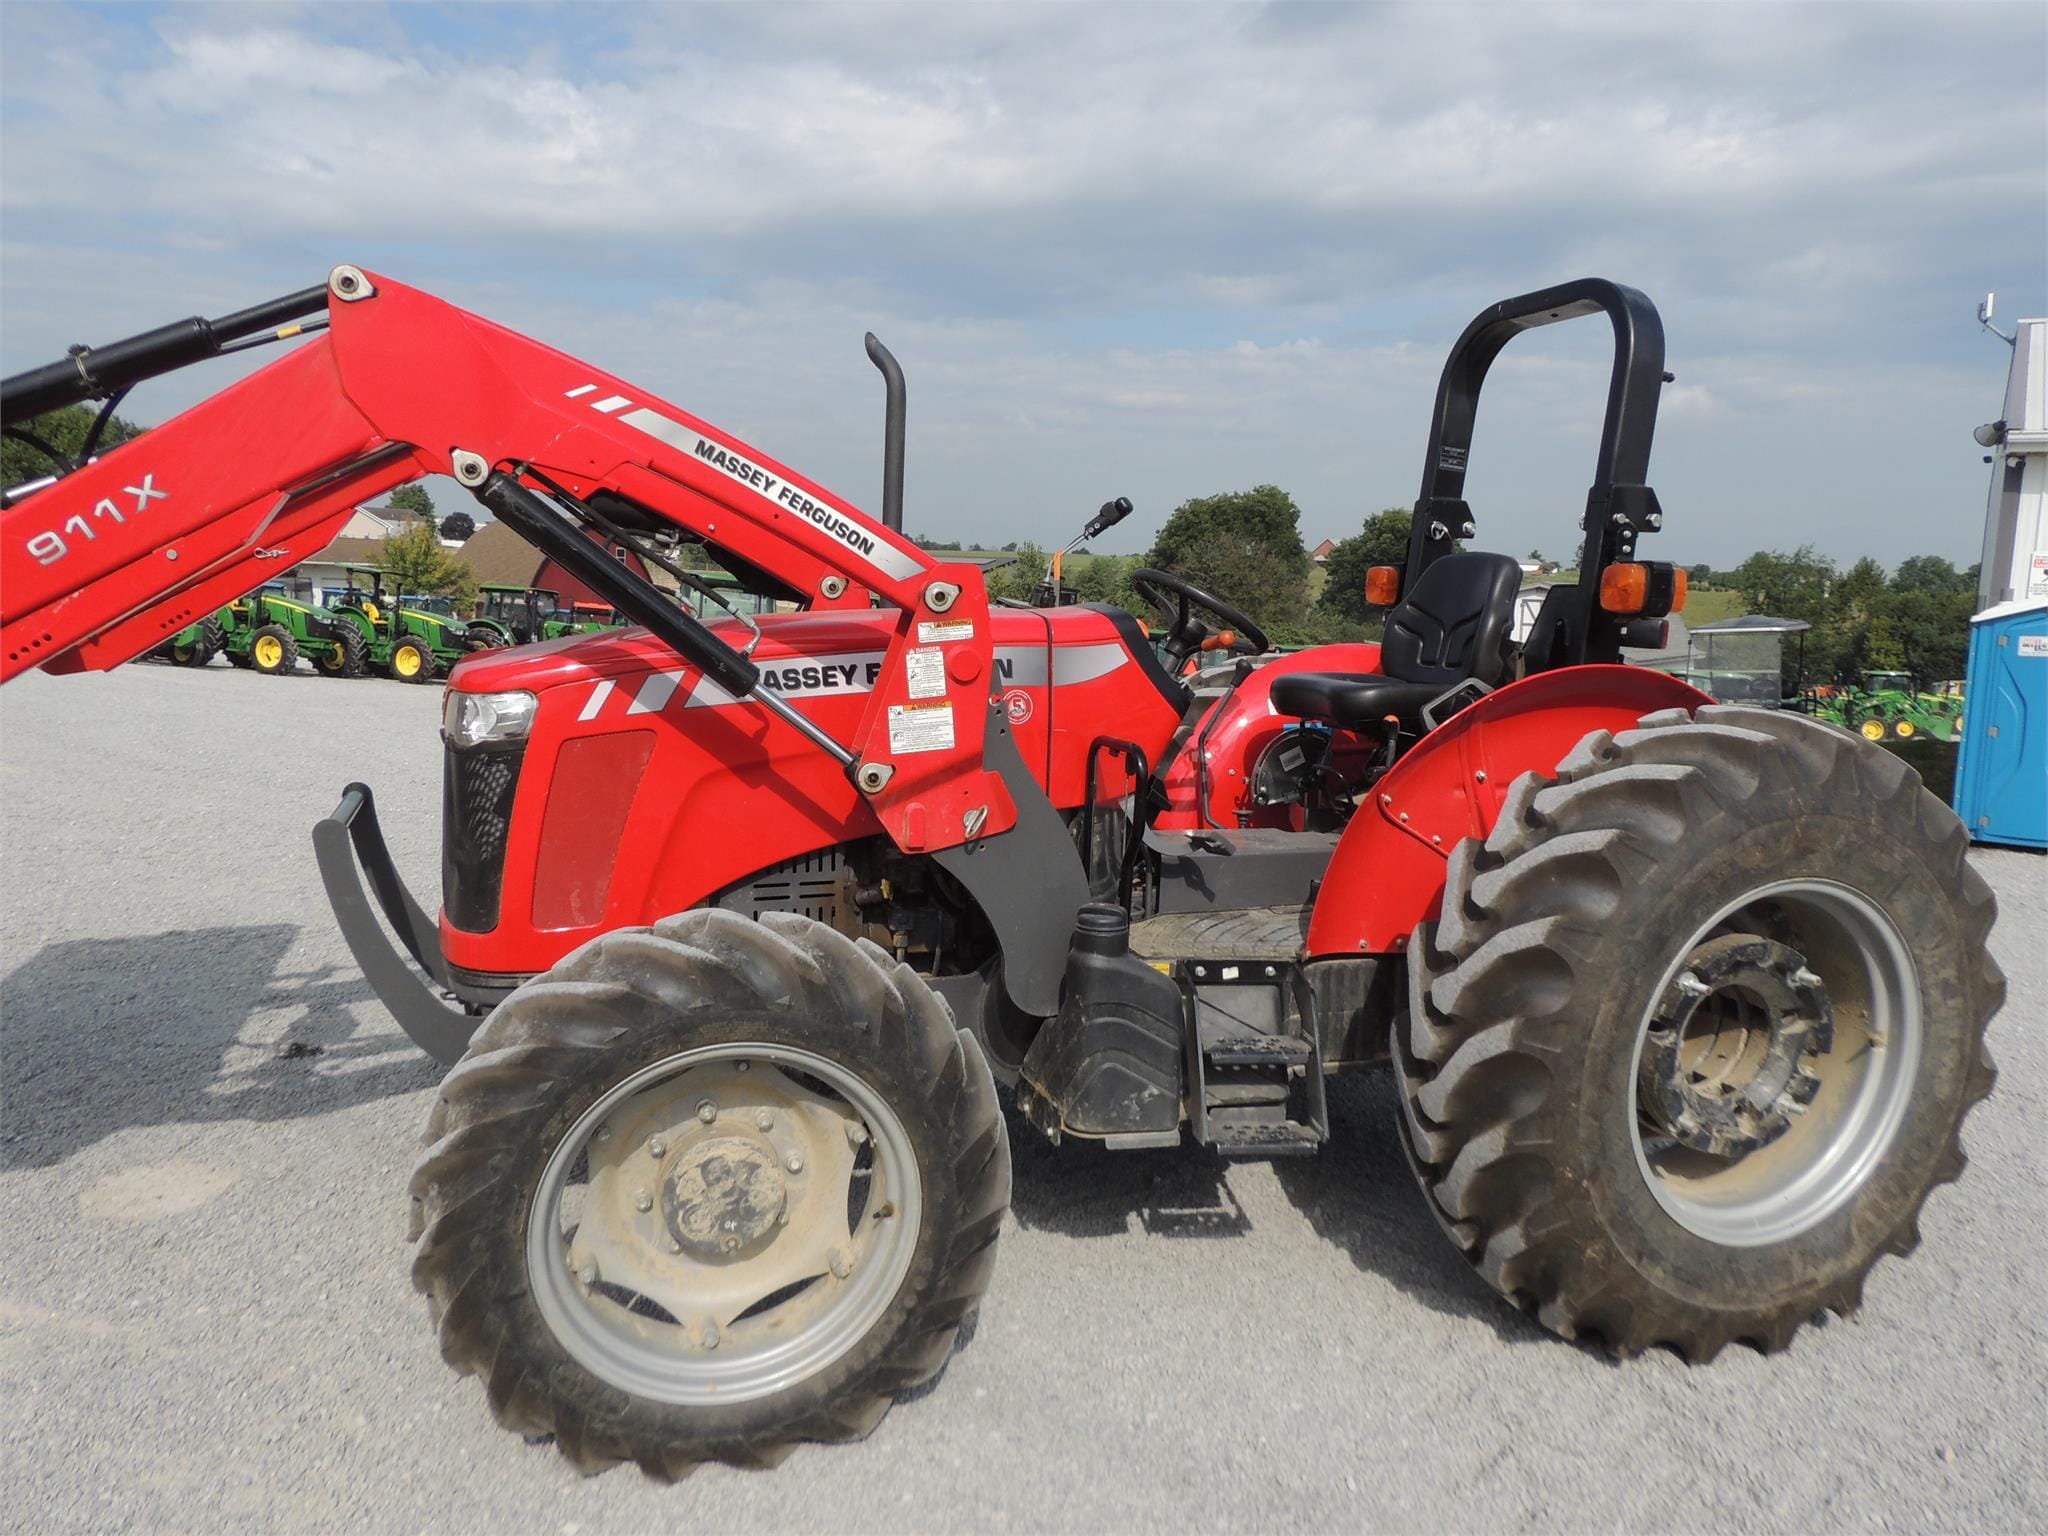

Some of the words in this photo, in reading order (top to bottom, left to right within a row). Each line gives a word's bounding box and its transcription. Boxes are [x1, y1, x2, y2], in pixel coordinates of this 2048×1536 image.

[26, 473, 169, 567] 911X
[694, 439, 777, 493] MASSEY
[777, 485, 875, 556] FERGUSON
[762, 664, 857, 691] ASSEY
[916, 646, 941, 654] DANGER
